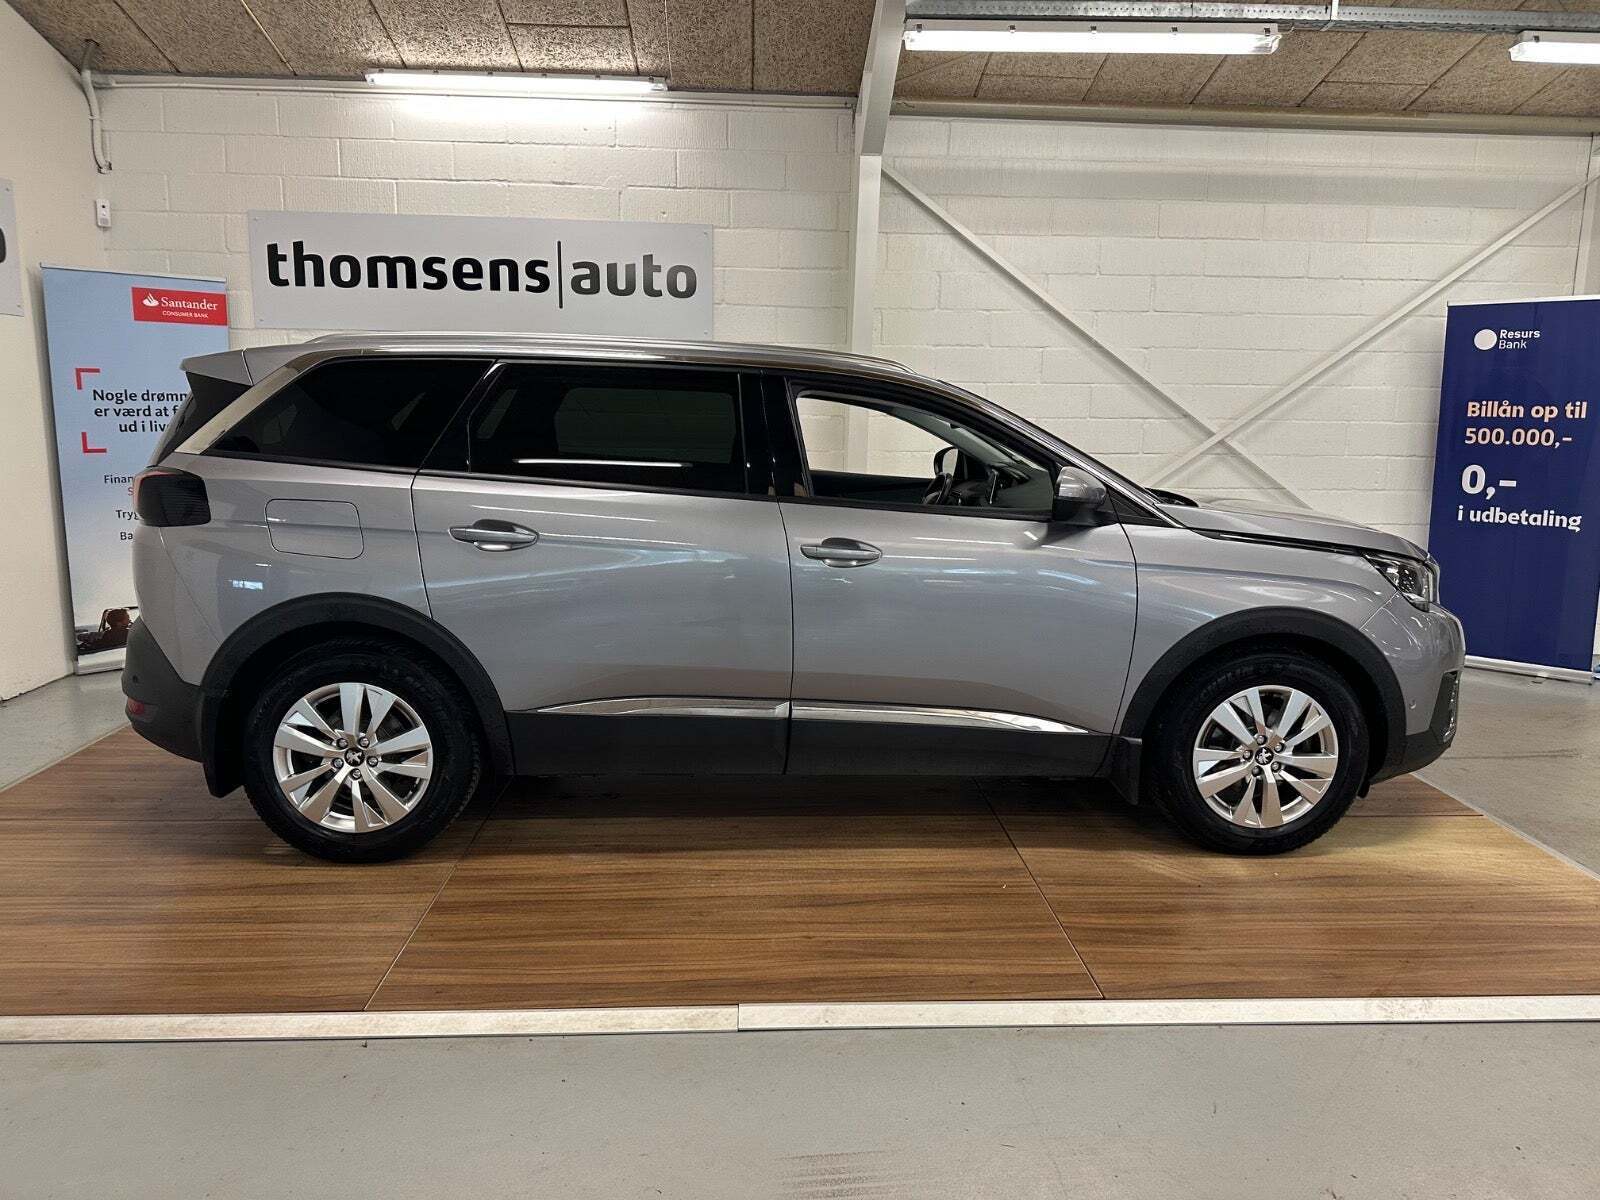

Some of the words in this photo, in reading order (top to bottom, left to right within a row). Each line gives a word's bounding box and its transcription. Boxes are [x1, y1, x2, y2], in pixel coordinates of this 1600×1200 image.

[266, 240, 551, 294] thomsens
[570, 253, 698, 299] auto
[160, 296, 219, 311] Santander
[162, 310, 193, 318] CONSUMER
[1499, 329, 1541, 340] Resurs
[1498, 339, 1527, 350] Bank
[92, 388, 138, 405] Nogle
[94, 407, 110, 417] er
[113, 405, 152, 417] værd
[155, 406, 170, 417] at
[1466, 400, 1525, 419] Billån
[1531, 406, 1559, 423] op
[1564, 400, 1588, 419] til
[118, 420, 138, 433] ud
[141, 420, 146, 433] i
[149, 420, 169, 433] liv
[1464, 427, 1573, 449] 500.000,-
[1457, 505, 1464, 522] i
[1469, 506, 1583, 533] udbetaling
